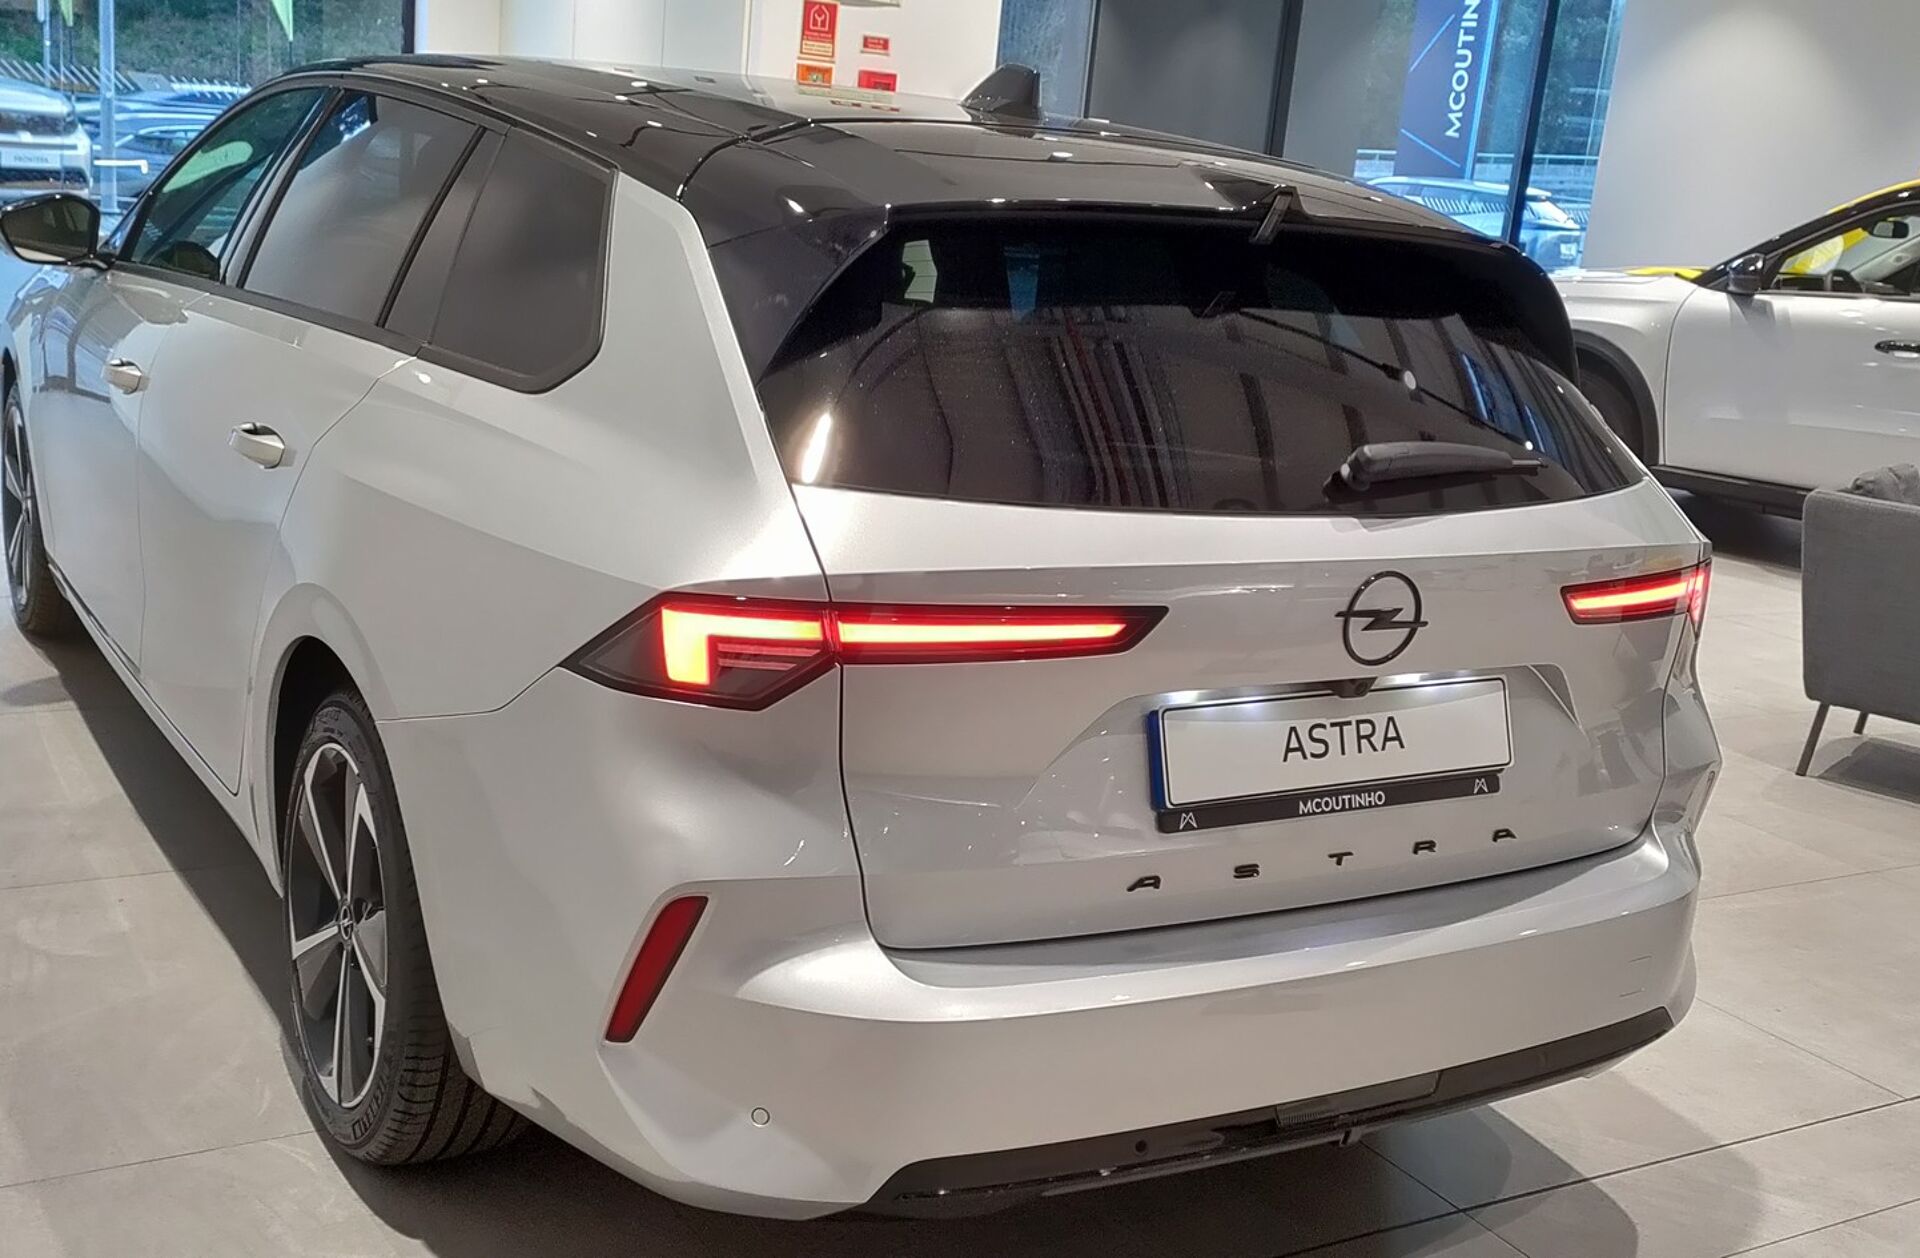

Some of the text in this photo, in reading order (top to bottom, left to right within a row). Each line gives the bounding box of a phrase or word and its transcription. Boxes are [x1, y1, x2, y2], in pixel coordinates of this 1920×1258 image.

[1445, 0, 1480, 138] MCOUTIN
[1282, 715, 1405, 763] ASTRA
[1298, 790, 1386, 815] MCOUTINHO
[1126, 827, 1517, 892] ASTRA
